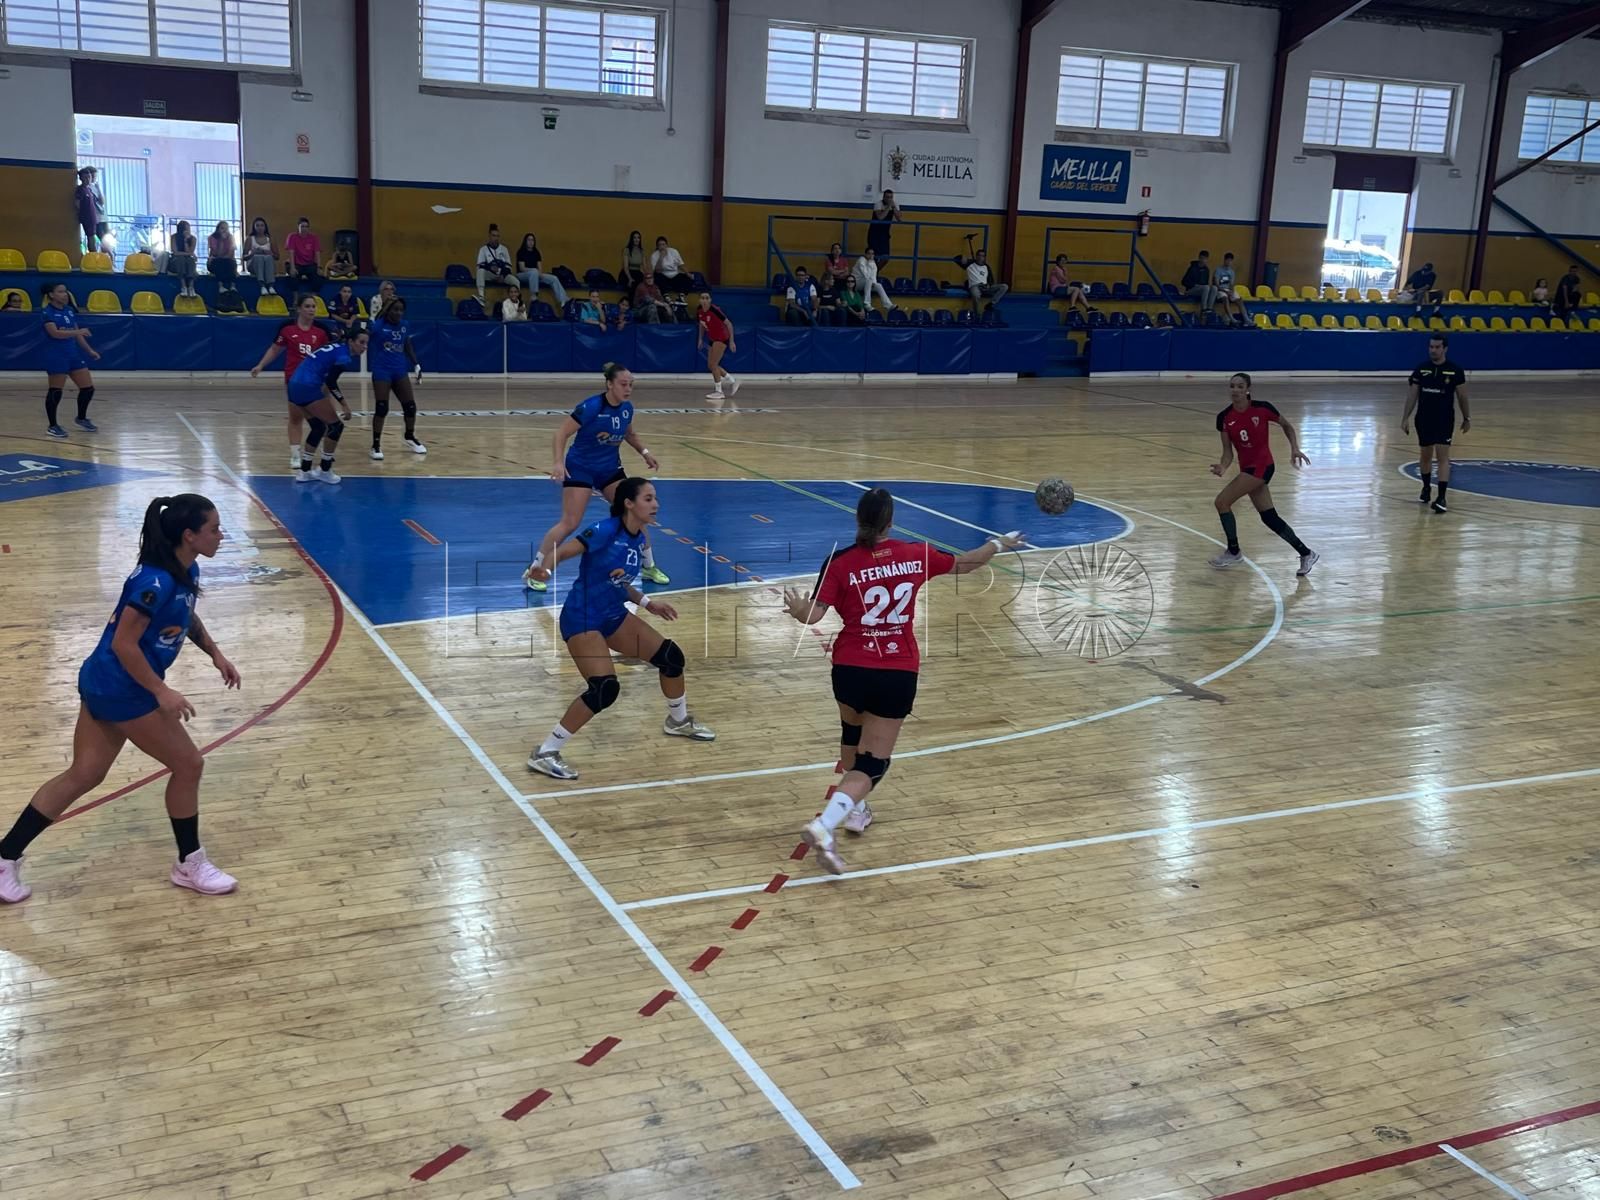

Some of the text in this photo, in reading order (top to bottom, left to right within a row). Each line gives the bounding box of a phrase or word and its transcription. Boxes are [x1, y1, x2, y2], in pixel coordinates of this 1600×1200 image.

[912, 154, 935, 162] CIUDAD
[913, 163, 973, 180] MELILLA
[1051, 158, 1122, 183] MELILLA
[611, 416, 621, 430] 19
[1240, 429, 1249, 442] 8
[626, 548, 639, 567] 23
[849, 561, 923, 585] A.FERNÁNDEZ
[861, 582, 914, 626] 22
